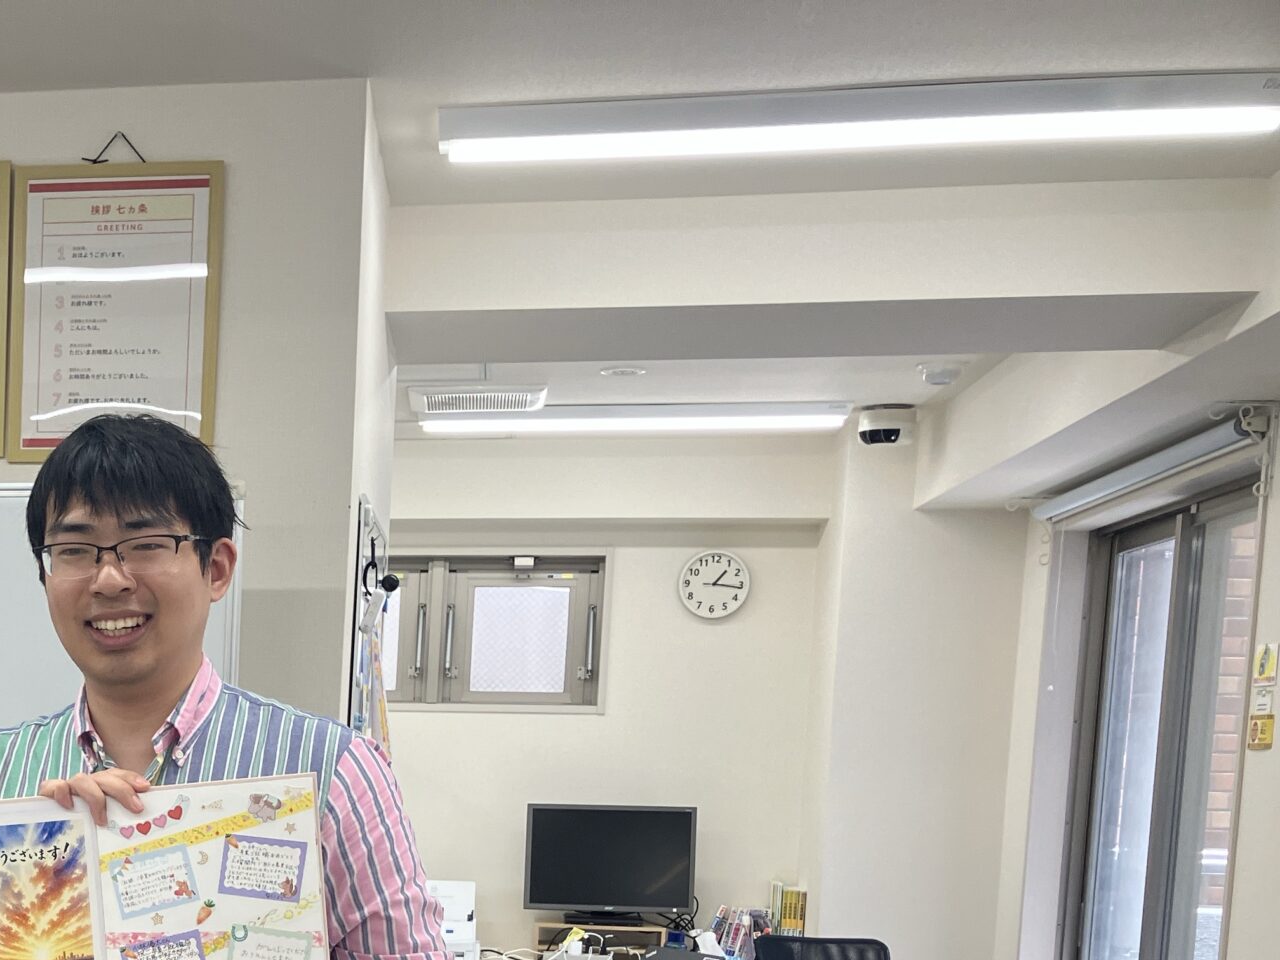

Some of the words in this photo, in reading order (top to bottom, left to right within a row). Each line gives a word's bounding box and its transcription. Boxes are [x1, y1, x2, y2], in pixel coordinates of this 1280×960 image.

[97, 224, 143, 232] GREETING
[699, 559, 709, 567] 11
[727, 559, 731, 567] 1
[689, 568, 700, 576] 10
[735, 568, 741, 577] 2
[684, 579, 690, 588] 9
[739, 581, 744, 589] 3
[687, 592, 694, 600] 8
[697, 601, 703, 609] 7
[709, 605, 715, 613] 6
[722, 602, 728, 611] 5
